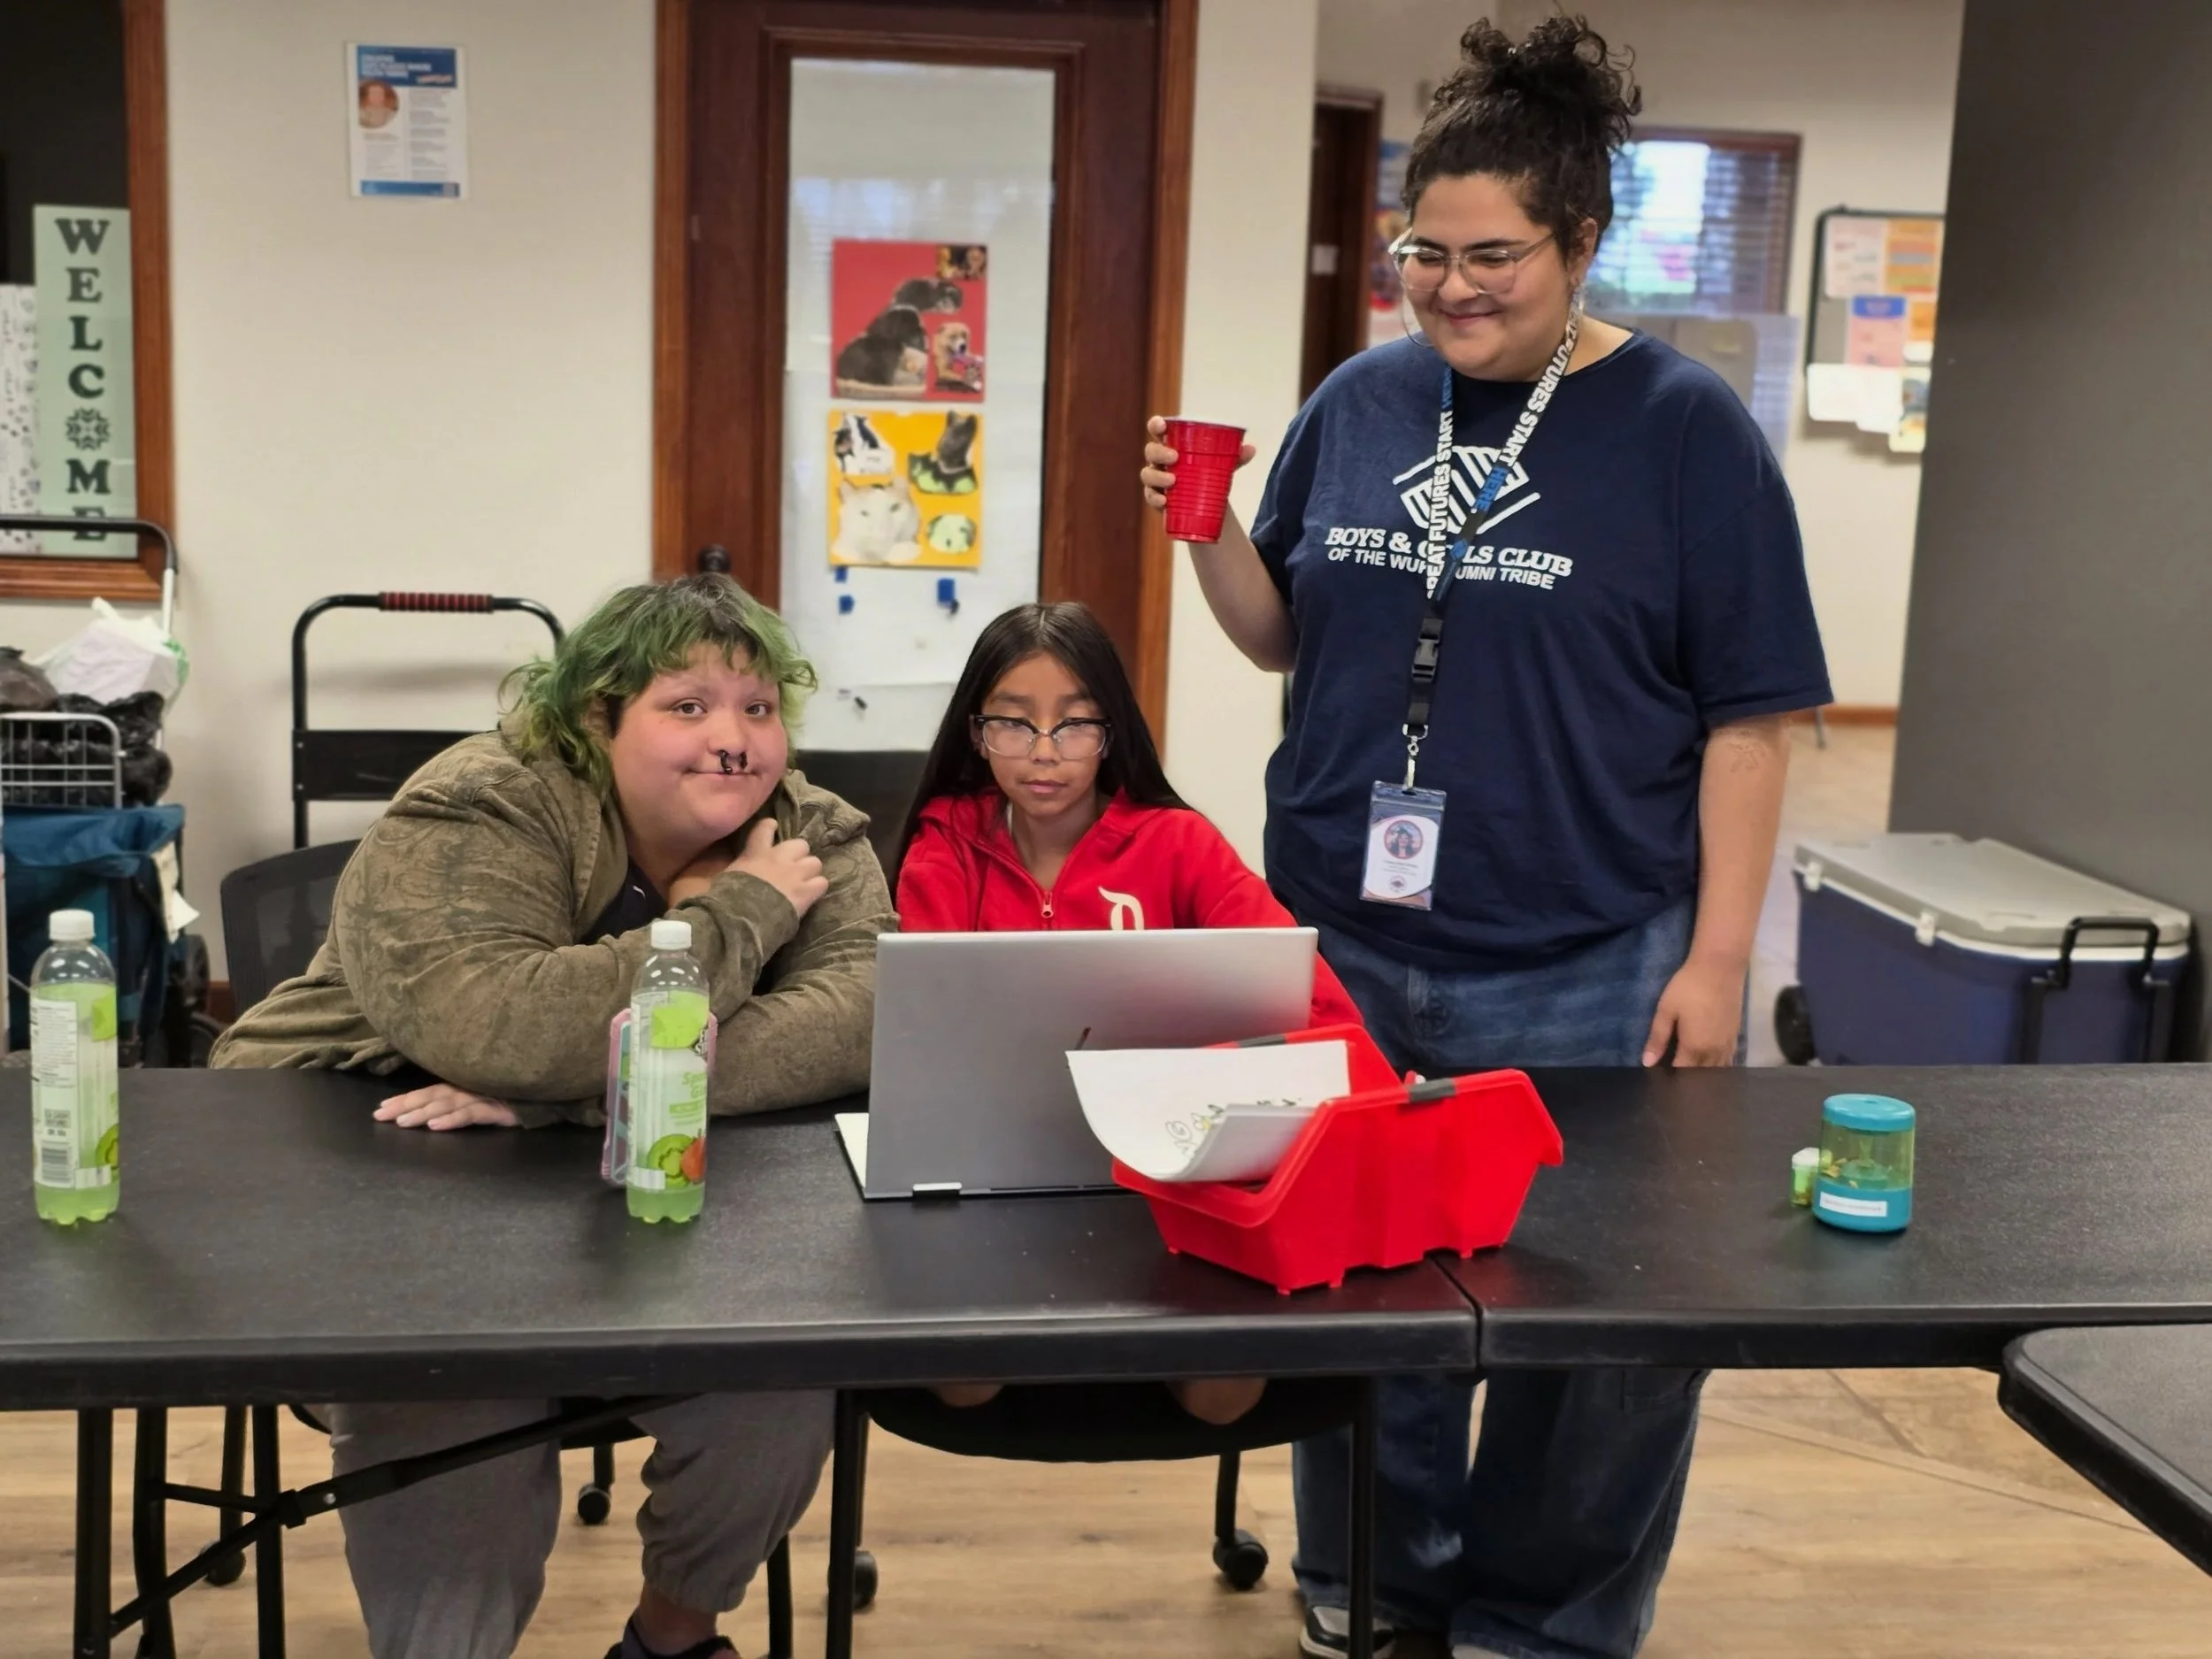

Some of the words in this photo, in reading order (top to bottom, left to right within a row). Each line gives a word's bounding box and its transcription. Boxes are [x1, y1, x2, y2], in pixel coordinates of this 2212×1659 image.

[1436, 410, 1454, 463] START
[1499, 411, 1538, 467] START
[1428, 463, 1451, 541] FUTURES
[1325, 527, 1386, 548] BOYS
[1388, 531, 1411, 554] &
[1417, 540, 1494, 564] GLS
[1498, 547, 1573, 577] CLUB
[1327, 547, 1352, 562] OF
[1355, 549, 1386, 566] THE
[1500, 567, 1556, 590] TRIBE
